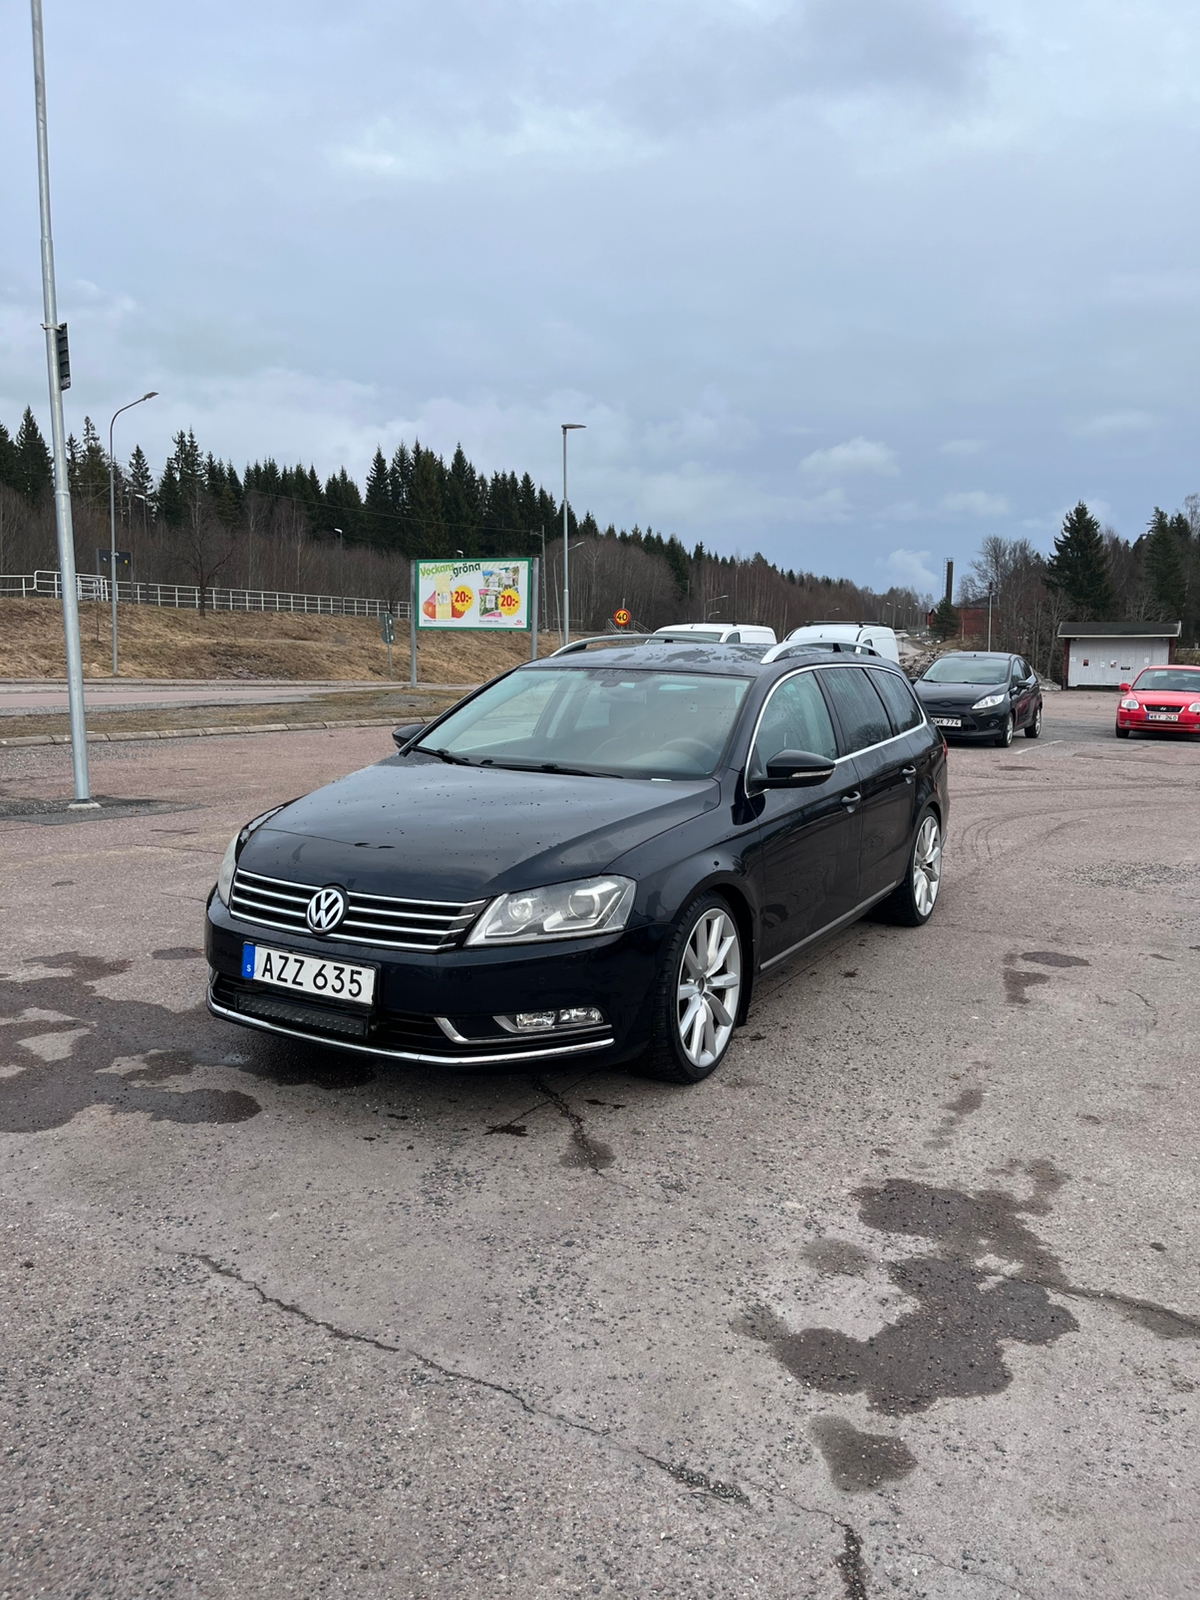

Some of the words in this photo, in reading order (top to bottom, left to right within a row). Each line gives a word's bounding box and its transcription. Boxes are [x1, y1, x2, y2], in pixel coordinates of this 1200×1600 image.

[420, 564, 454, 576] Veckans
[452, 563, 481, 577] gröna
[454, 591, 472, 603] 20:-
[501, 595, 518, 607] 20:-
[616, 612, 628, 621] 40
[307, 888, 344, 932] VW
[246, 964, 252, 972] S
[261, 952, 305, 987] AZZ
[313, 964, 363, 998] 635
